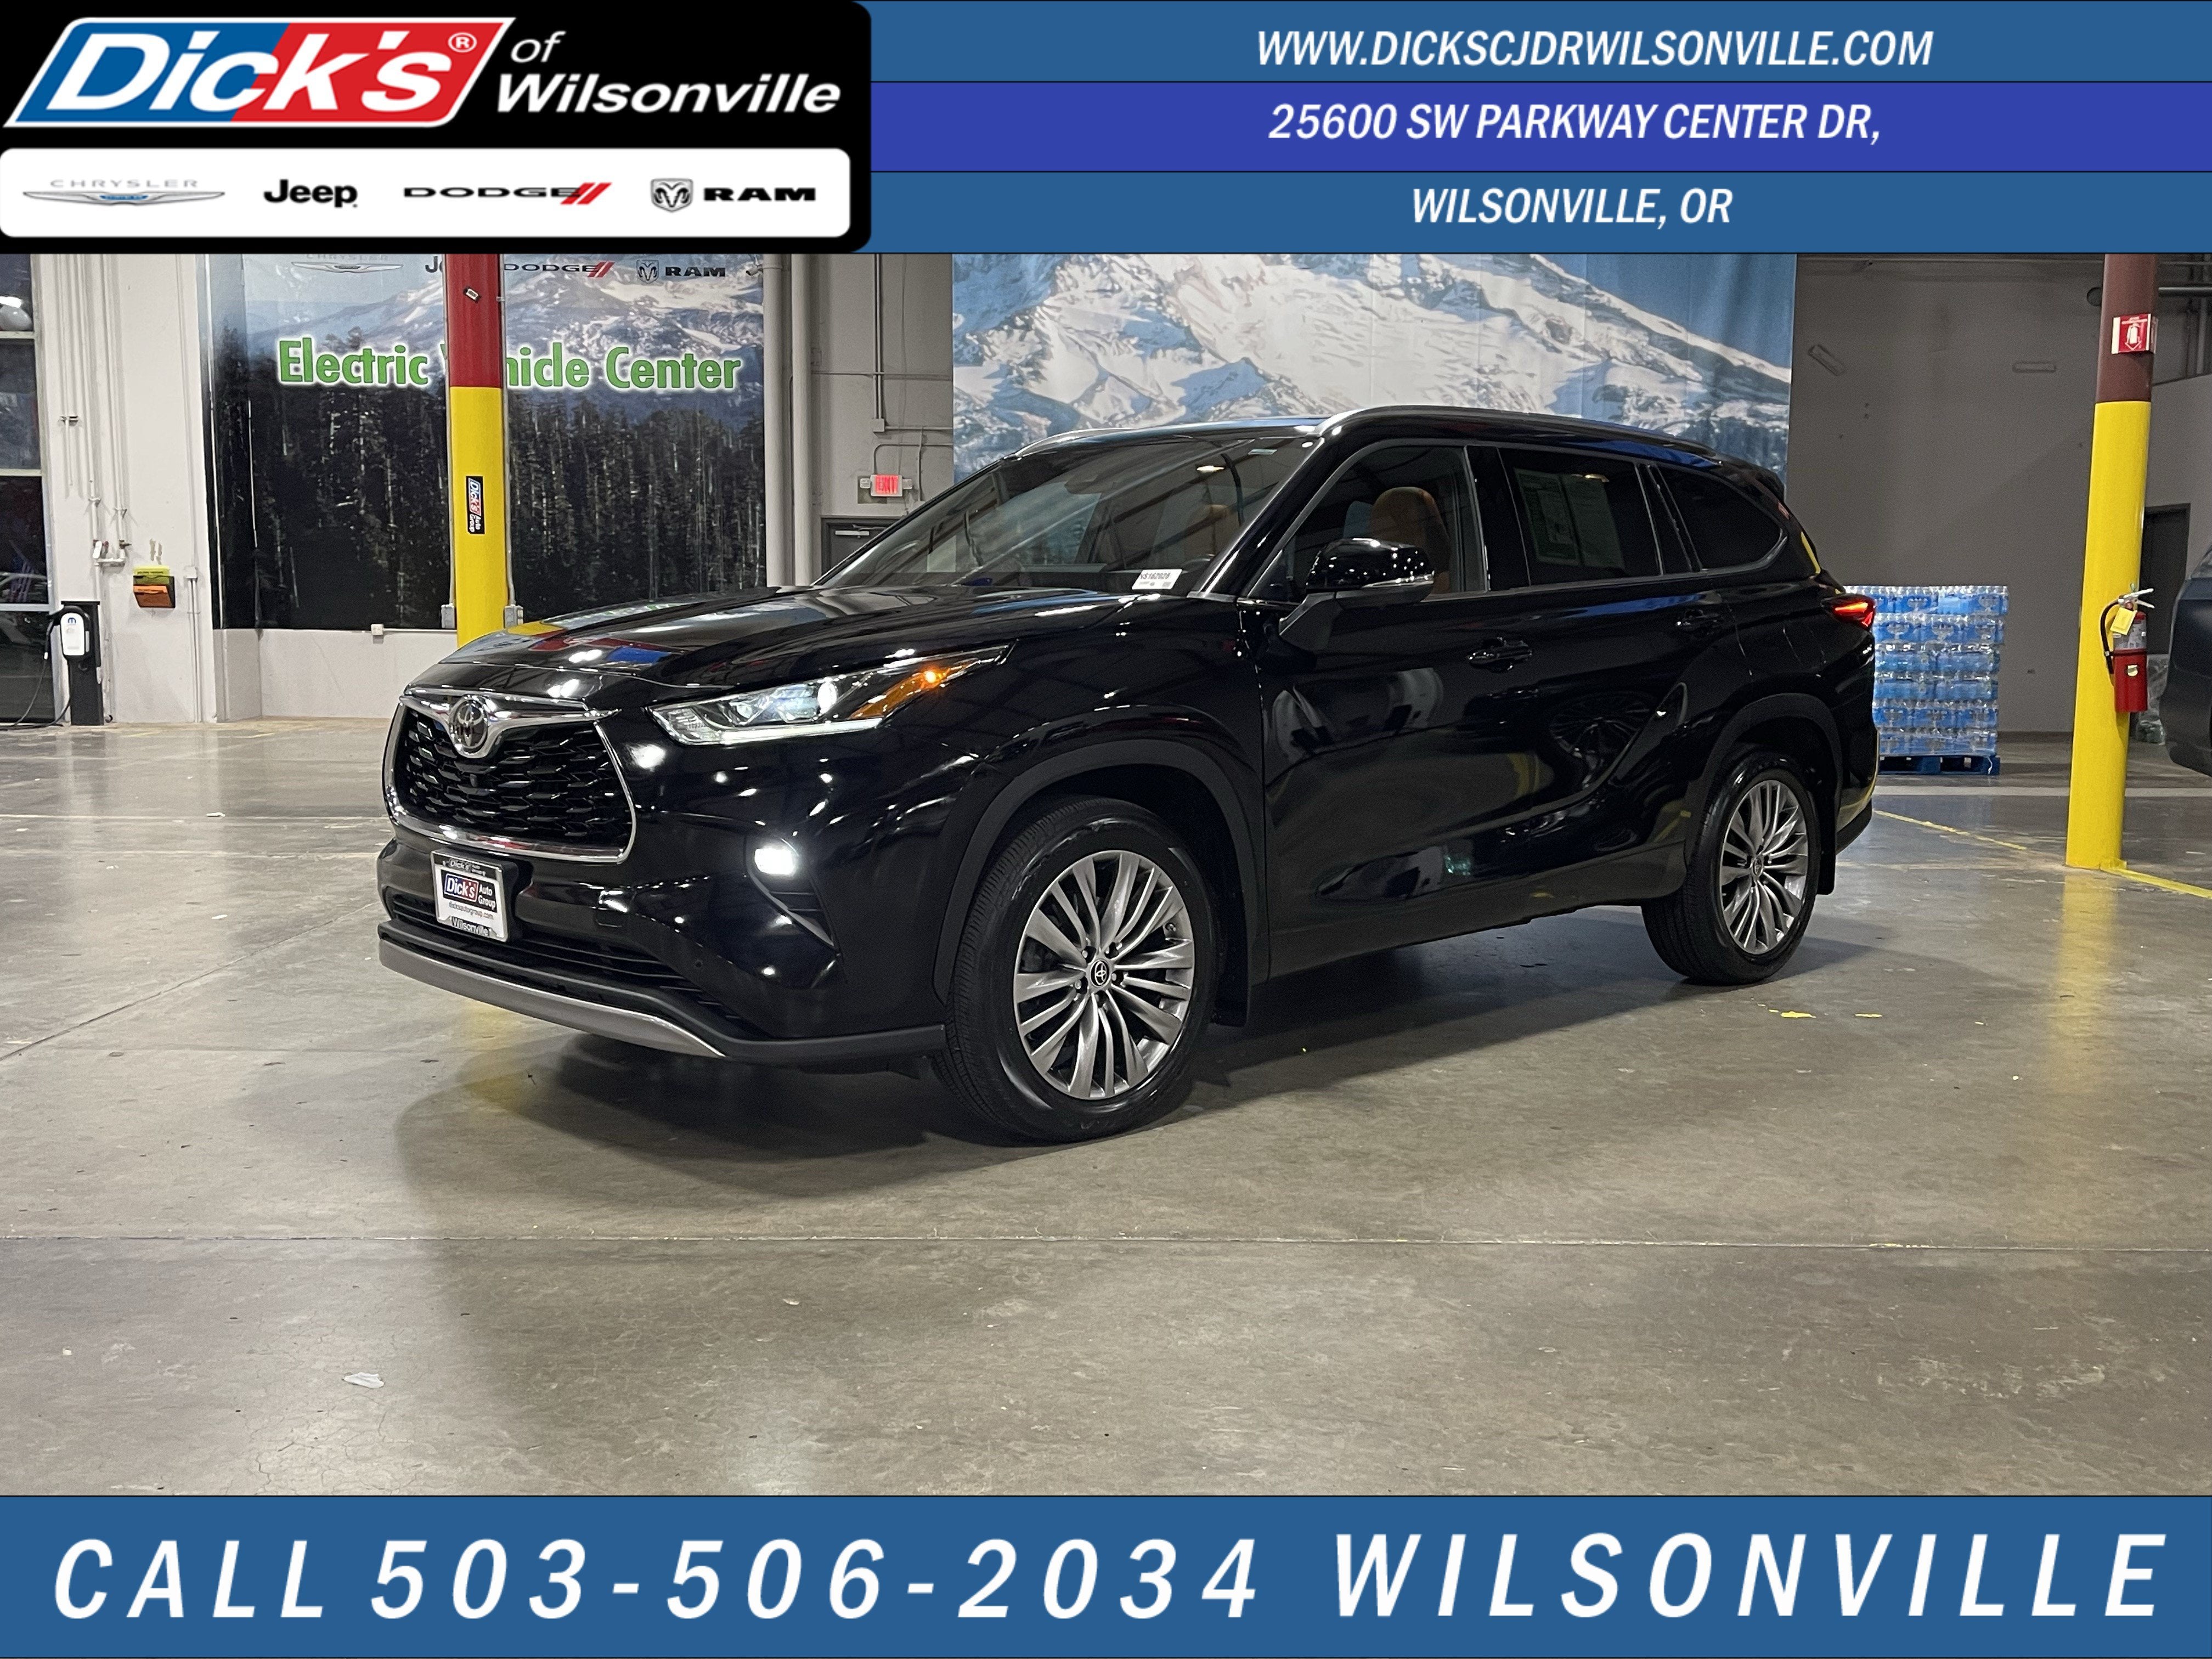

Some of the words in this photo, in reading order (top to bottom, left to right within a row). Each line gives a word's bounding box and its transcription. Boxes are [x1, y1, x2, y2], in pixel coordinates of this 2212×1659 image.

[504, 263, 599, 272] DODGE
[665, 266, 726, 278] RAM
[279, 337, 428, 385] Electric
[606, 346, 741, 389] Center
[876, 475, 899, 494] EXIT
[447, 877, 476, 899] Dick's
[479, 884, 493, 896] Auto
[478, 894, 496, 910] Group
